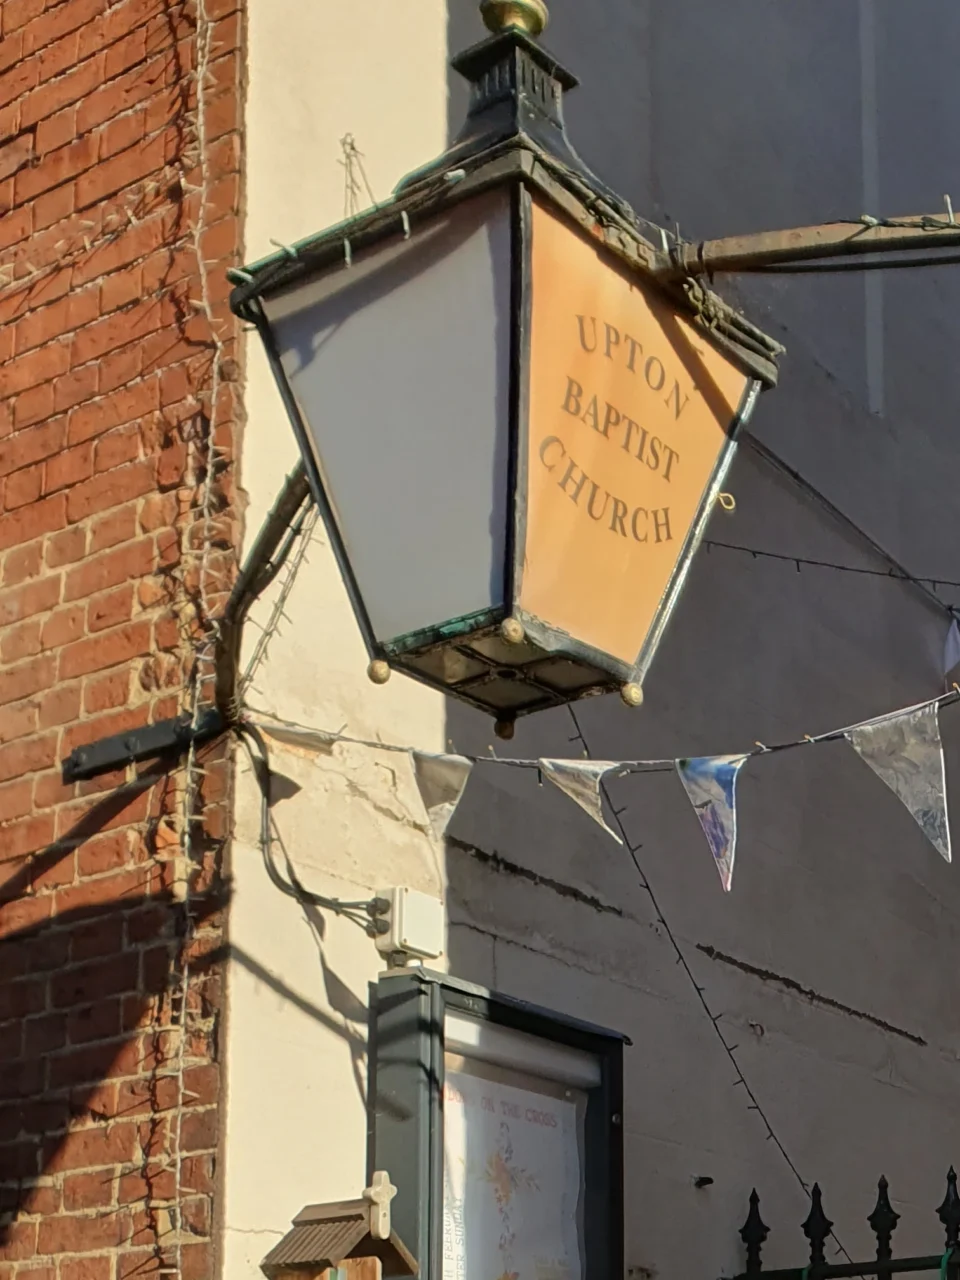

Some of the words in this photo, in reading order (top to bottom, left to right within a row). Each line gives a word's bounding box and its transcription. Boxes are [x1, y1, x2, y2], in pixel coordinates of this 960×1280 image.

[575, 314, 690, 421] UPTON
[561, 375, 680, 483] BAPTIST
[538, 434, 673, 544] CHURCH
[451, 1196, 465, 1247] SUNDAY
